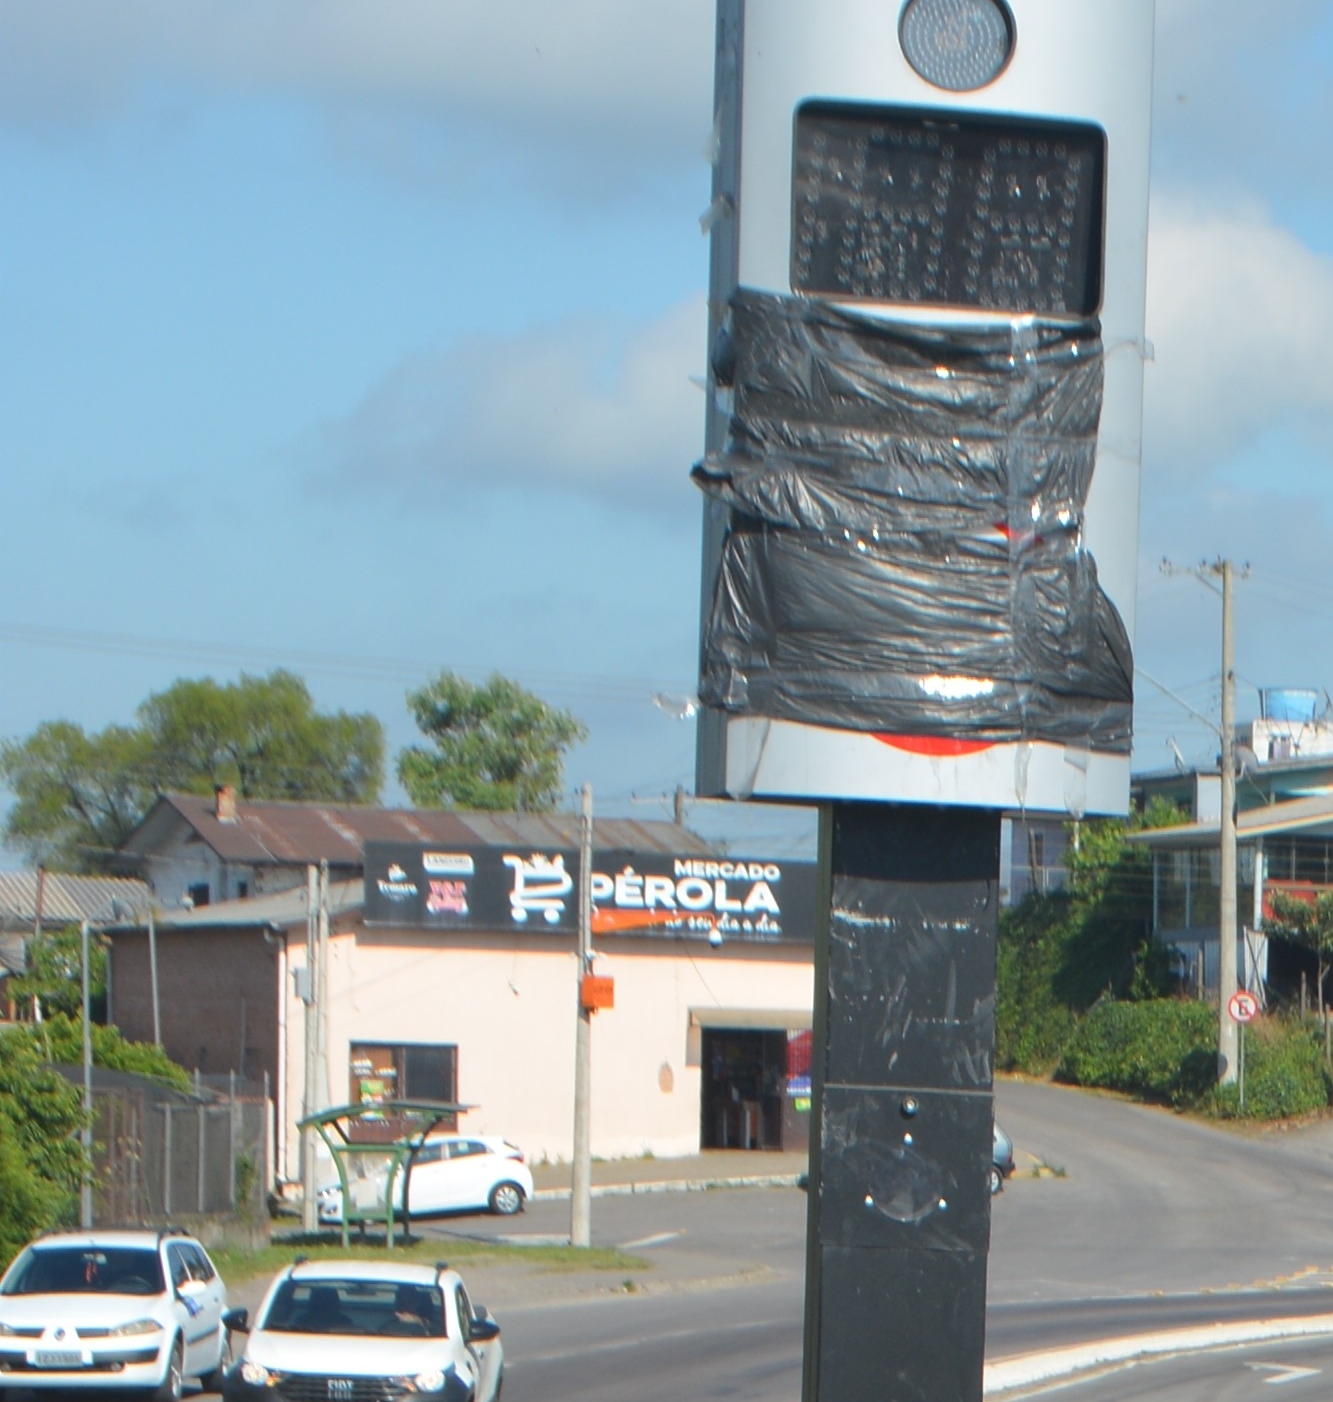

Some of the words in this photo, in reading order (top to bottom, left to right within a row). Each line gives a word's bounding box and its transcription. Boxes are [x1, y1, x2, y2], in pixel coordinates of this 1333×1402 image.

[674, 859, 780, 881] MERCADO
[591, 865, 781, 916] PÉROLA
[327, 1379, 354, 1390] FIAT
